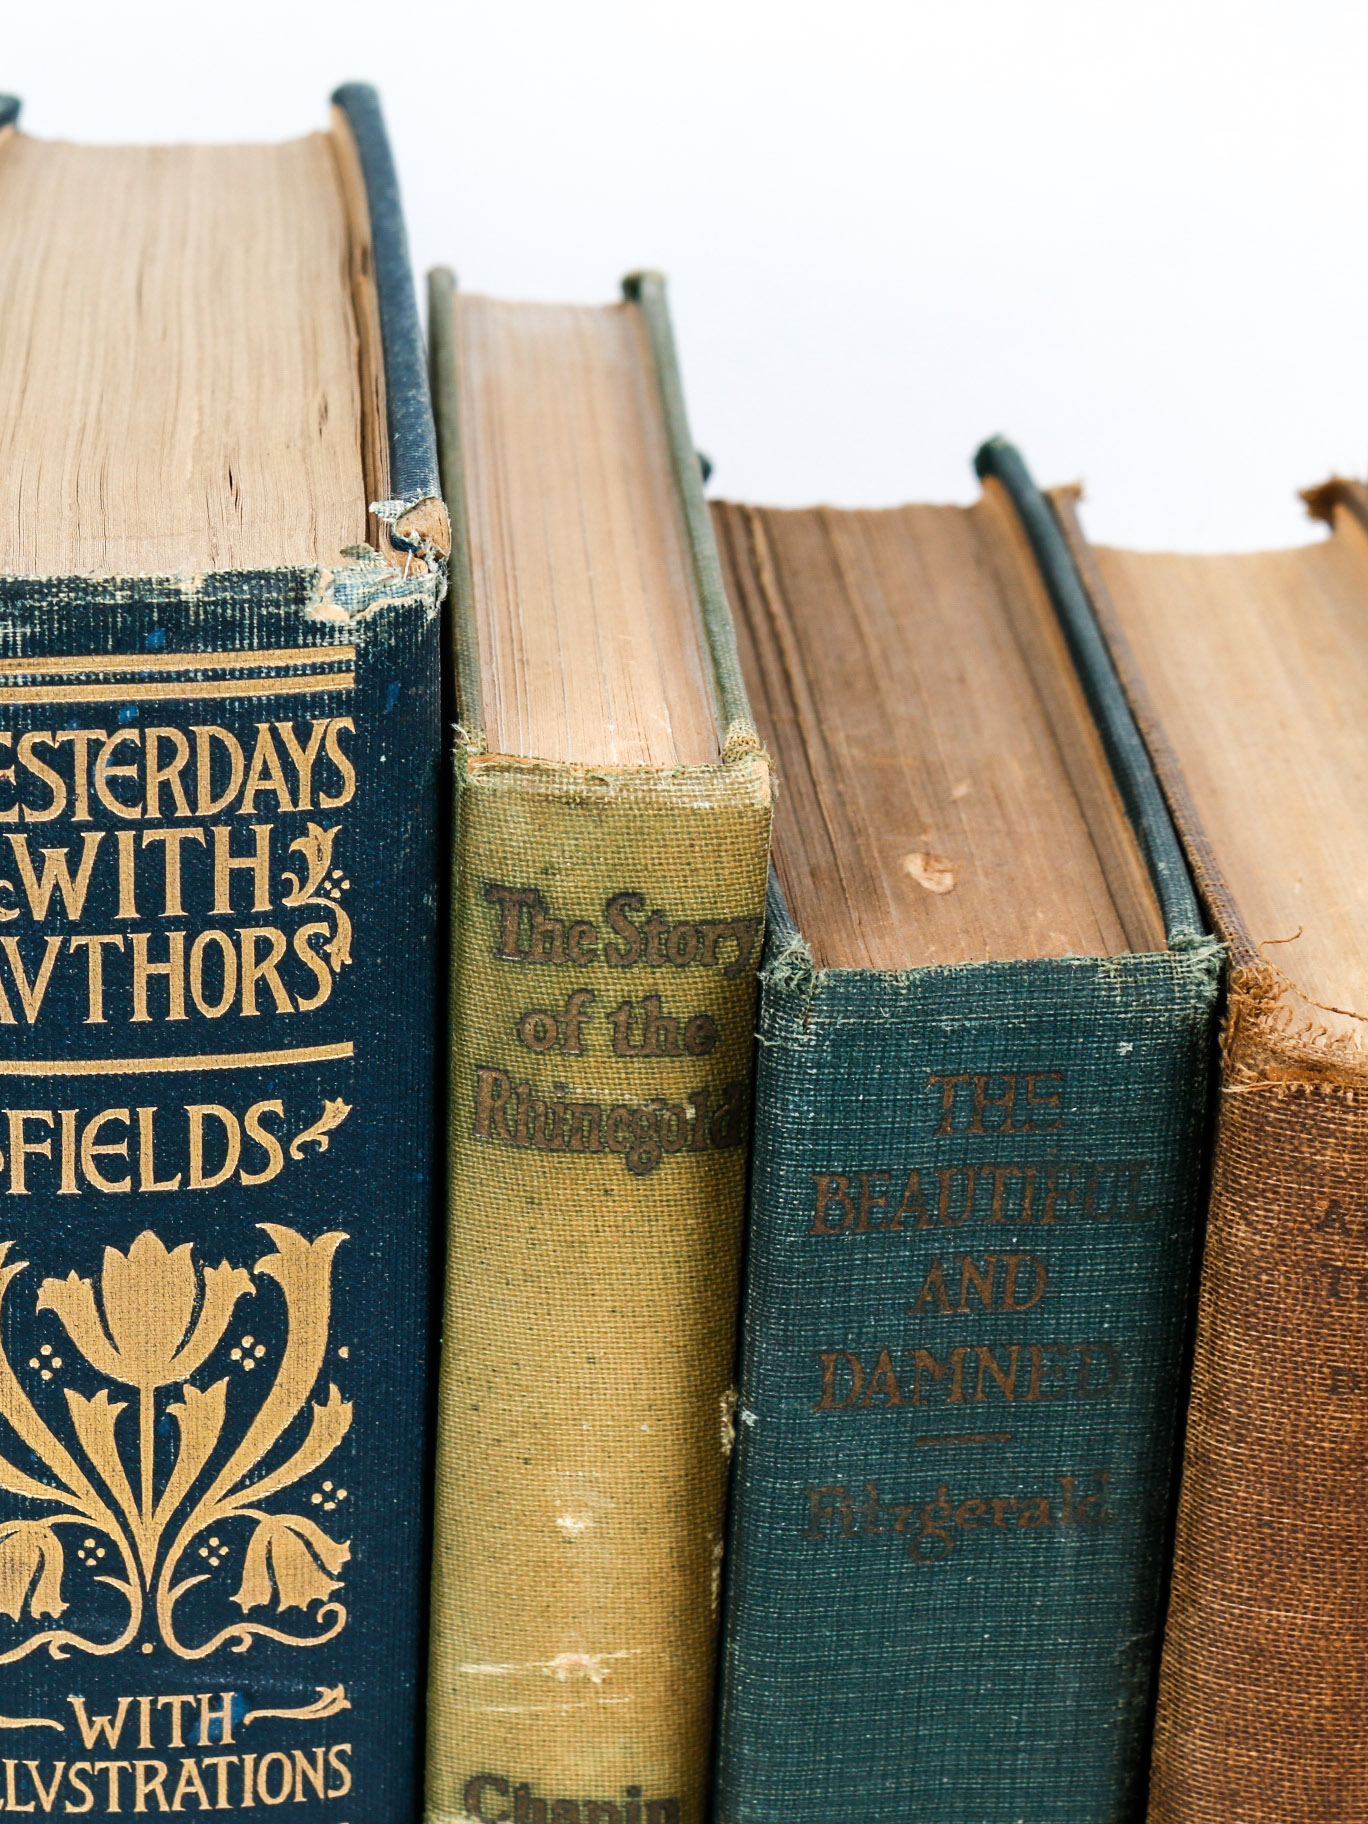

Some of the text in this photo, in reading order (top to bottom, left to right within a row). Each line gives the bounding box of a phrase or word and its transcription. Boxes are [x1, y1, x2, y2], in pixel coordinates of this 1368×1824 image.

[2, 823, 275, 921] WITH
[483, 882, 766, 978] The Story
[519, 988, 718, 1058] of the
[474, 1065, 746, 1173] Rhinegold
[926, 1070, 1064, 1137] THE
[2, 1099, 285, 1195] FIELDS
[807, 1158, 1158, 1236] BEAUTIFUL
[907, 1253, 1049, 1316] AND
[813, 1343, 1124, 1412] DAMNED
[800, 1471, 1117, 1564] Fitzgerald
[66, 1691, 238, 1751] WITH
